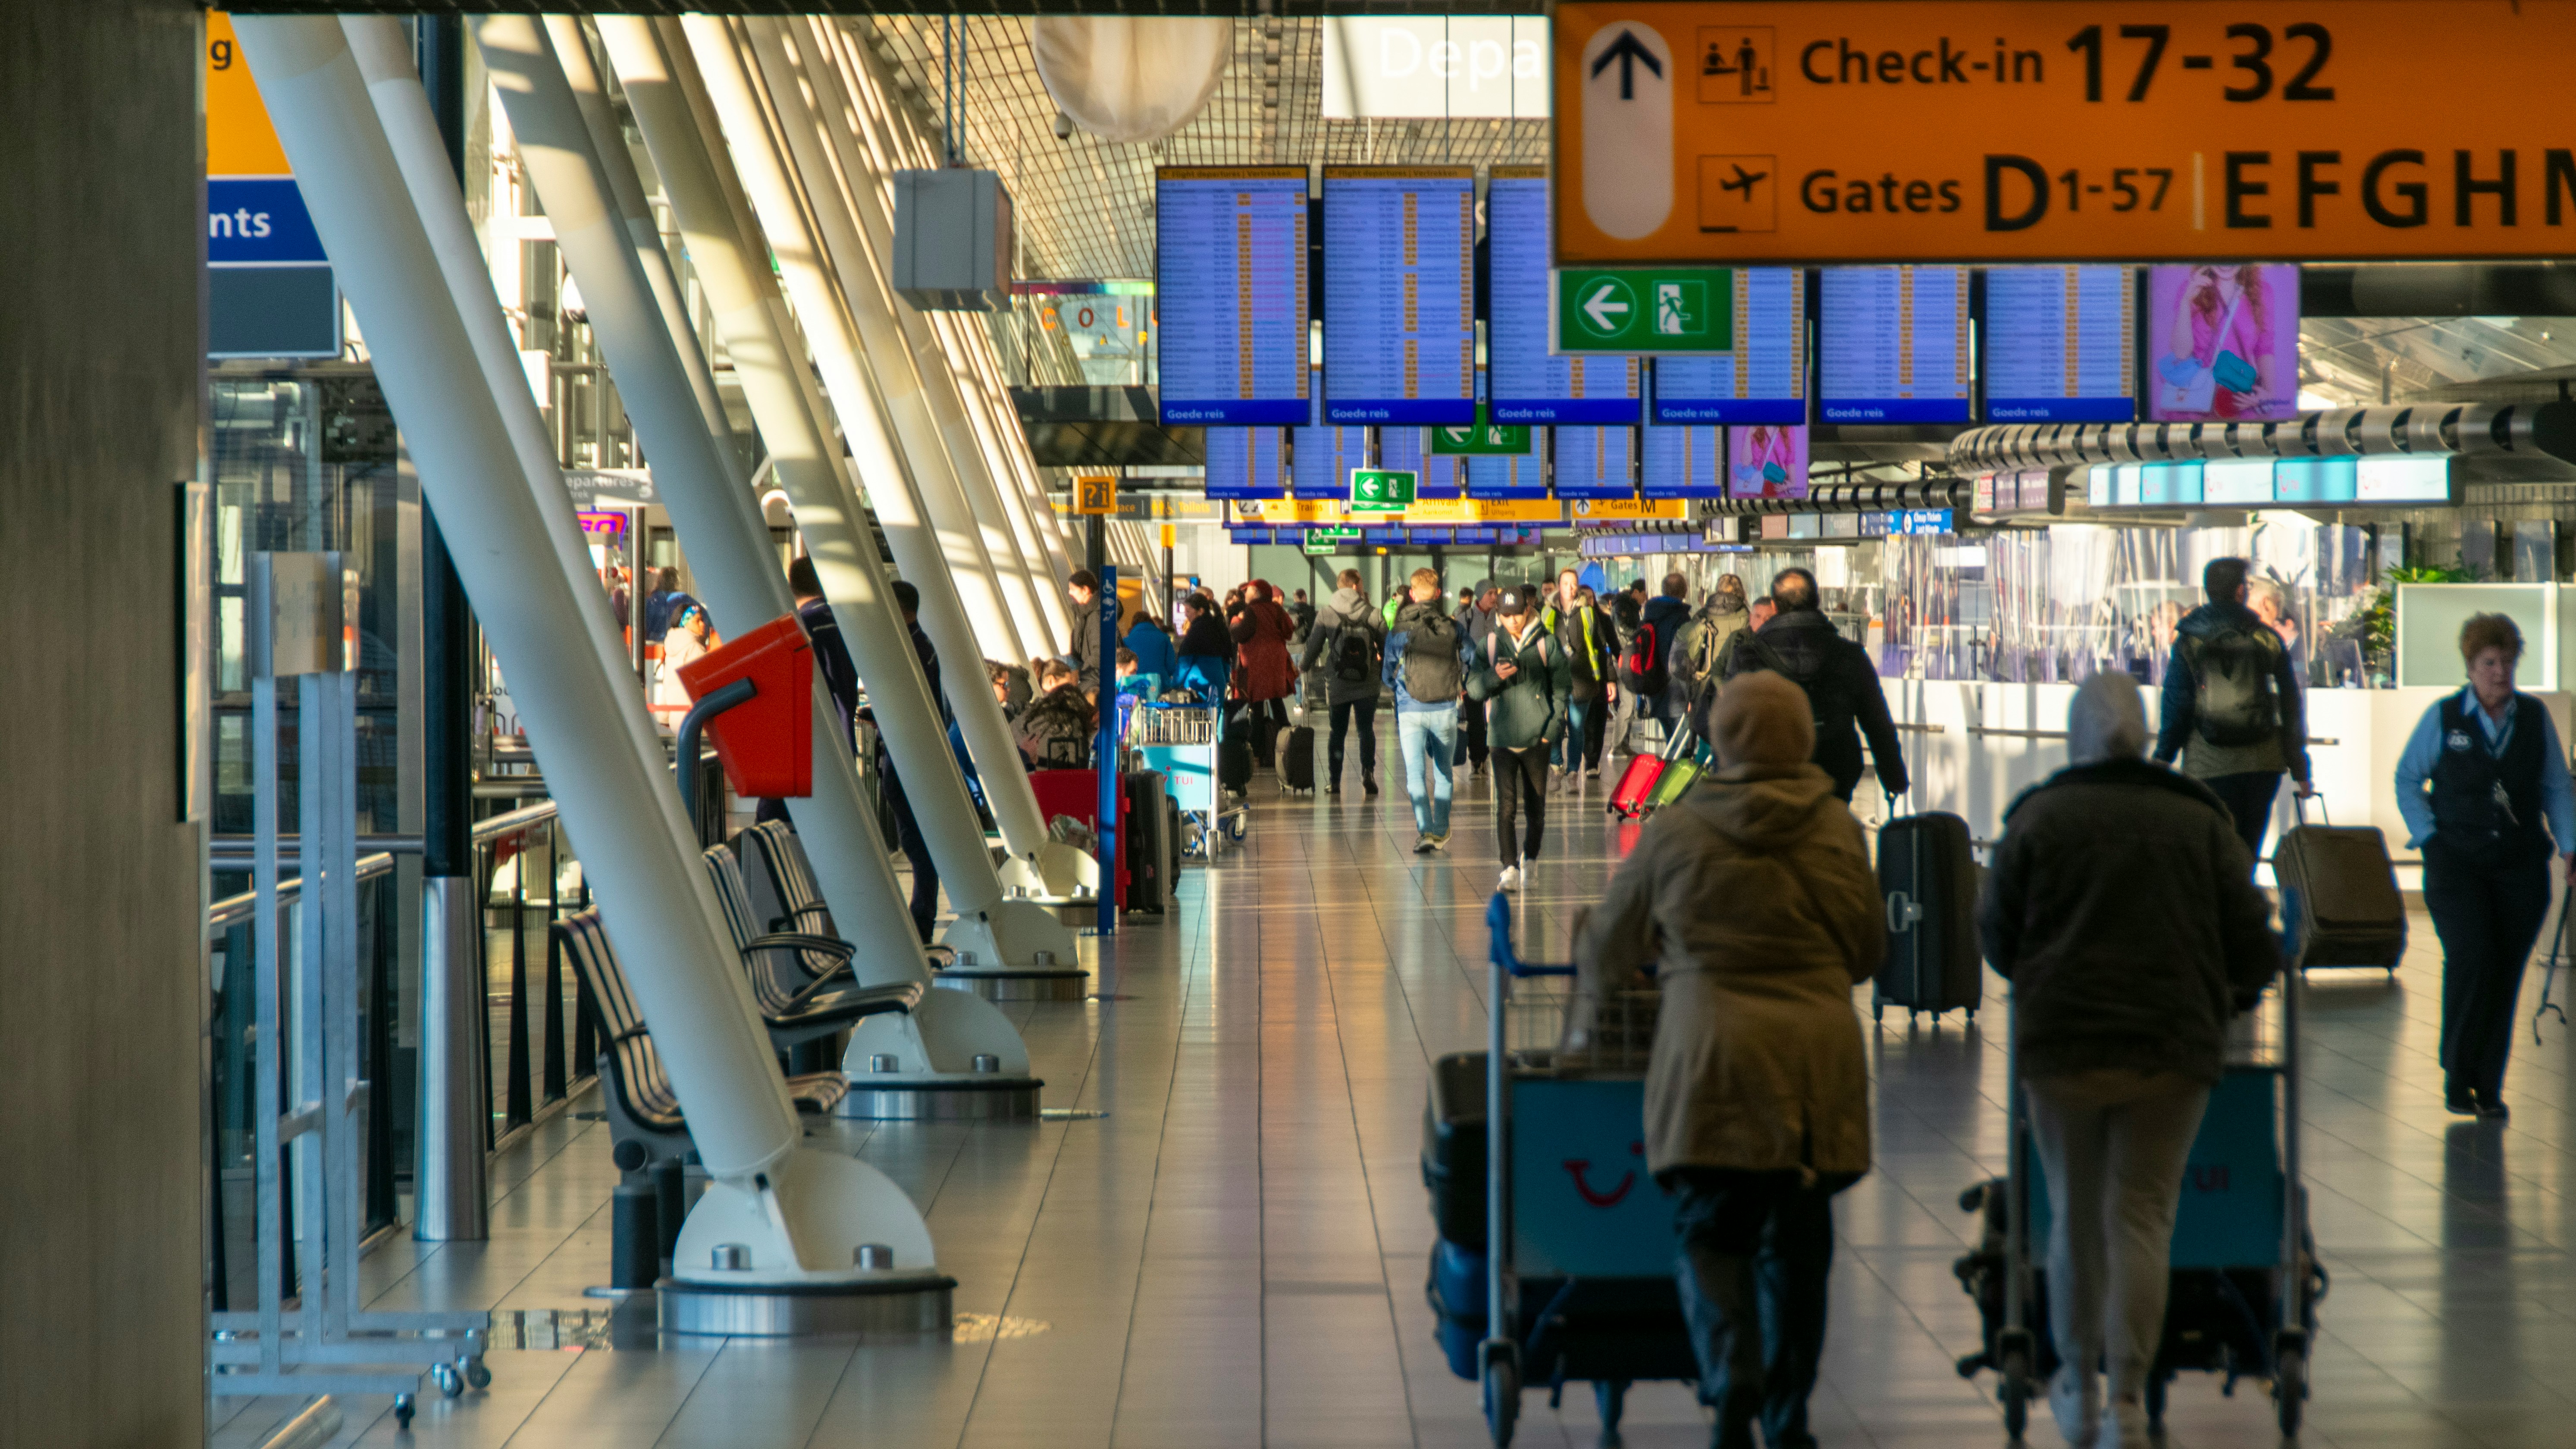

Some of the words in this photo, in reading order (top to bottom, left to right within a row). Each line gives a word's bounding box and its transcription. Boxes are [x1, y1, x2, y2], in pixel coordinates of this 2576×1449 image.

[1801, 38, 2043, 84] Check-in
[2066, 22, 2335, 103] 17-32
[1800, 169, 1962, 213] Gates
[1167, 409, 1203, 419] Goede
[1205, 409, 1225, 419] reis
[1332, 408, 1367, 418] Goede
[1369, 408, 1389, 418] reis
[1498, 408, 1532, 418] Goede
[1536, 408, 1555, 418] reis
[1662, 408, 1697, 418] Goede
[1700, 408, 1719, 418] reis
[1827, 408, 1861, 417] Goede
[1864, 408, 1883, 417] reis
[1993, 407, 2027, 417] Goede
[2030, 407, 2049, 417] reis
[1178, 501, 1211, 513] Toilets
[1297, 502, 1323, 512] Trains
[1611, 500, 1638, 510] Gates
[1641, 499, 1656, 513] M
[1927, 511, 1942, 522] Tickets
[1174, 776, 1193, 785] TUI
